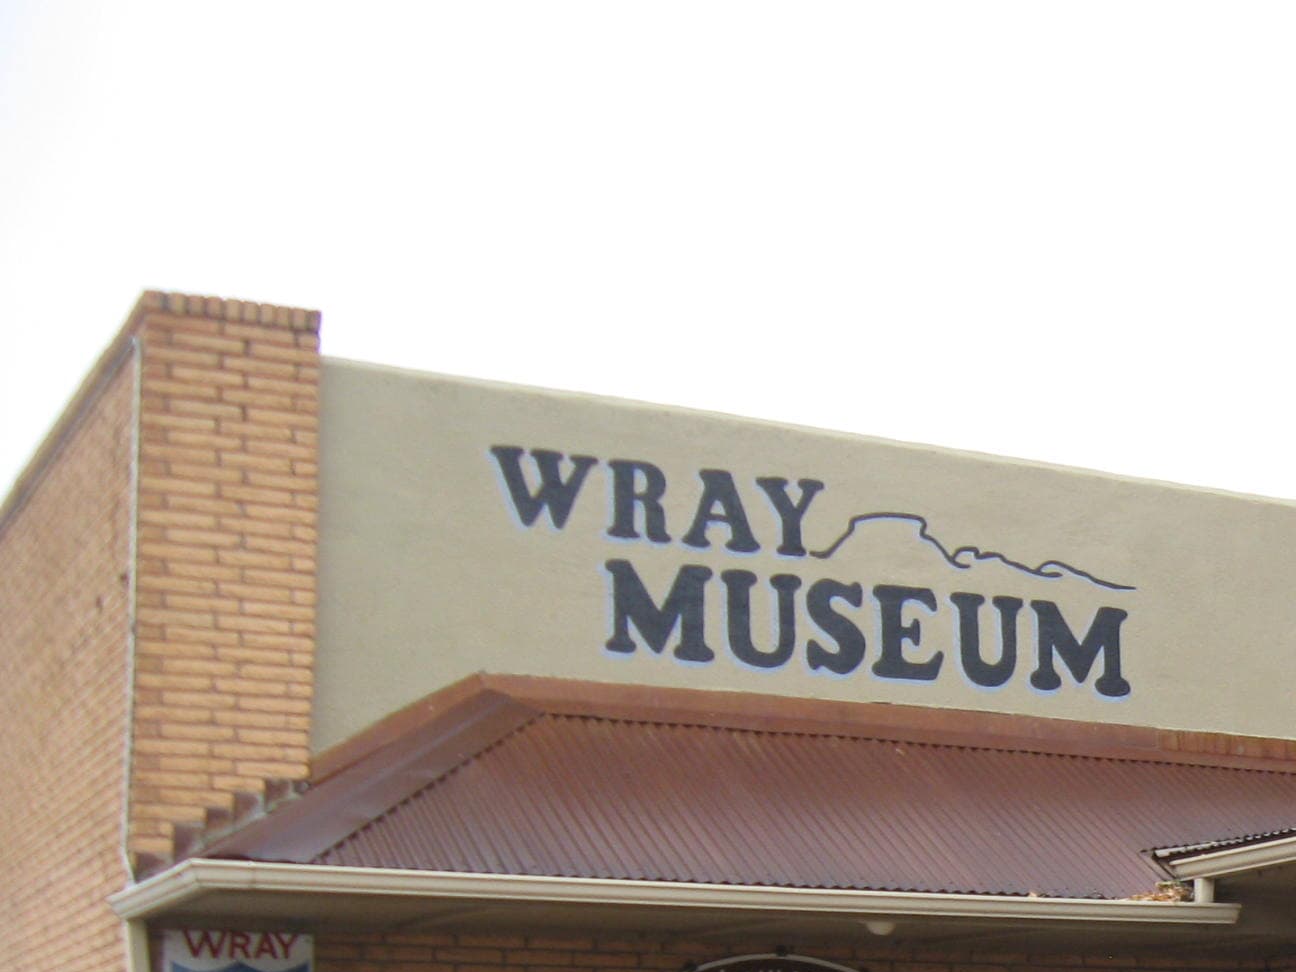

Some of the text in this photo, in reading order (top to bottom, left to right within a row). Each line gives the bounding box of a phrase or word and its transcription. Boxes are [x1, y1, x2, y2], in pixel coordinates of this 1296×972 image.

[491, 445, 825, 557] WRAY
[605, 558, 1132, 698] MUSEUM
[183, 927, 298, 959] WRAY
